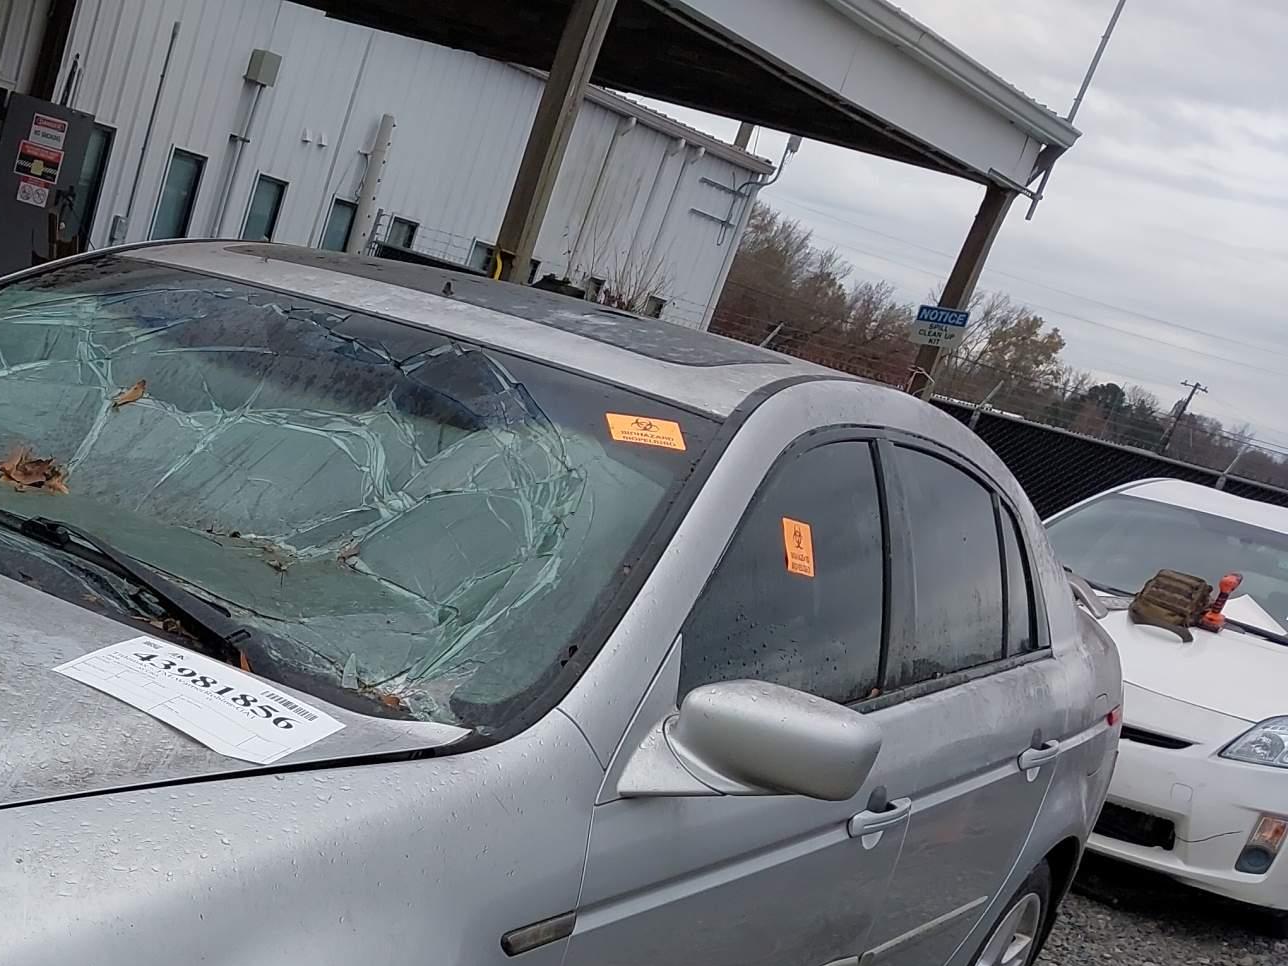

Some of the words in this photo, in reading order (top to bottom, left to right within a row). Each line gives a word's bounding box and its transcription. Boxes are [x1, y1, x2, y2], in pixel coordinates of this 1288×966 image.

[919, 308, 967, 325] NOTICE
[929, 323, 948, 332] SPILL
[919, 329, 942, 338] CLEAN
[944, 333, 955, 341] UP
[132, 651, 304, 730] 43981856
